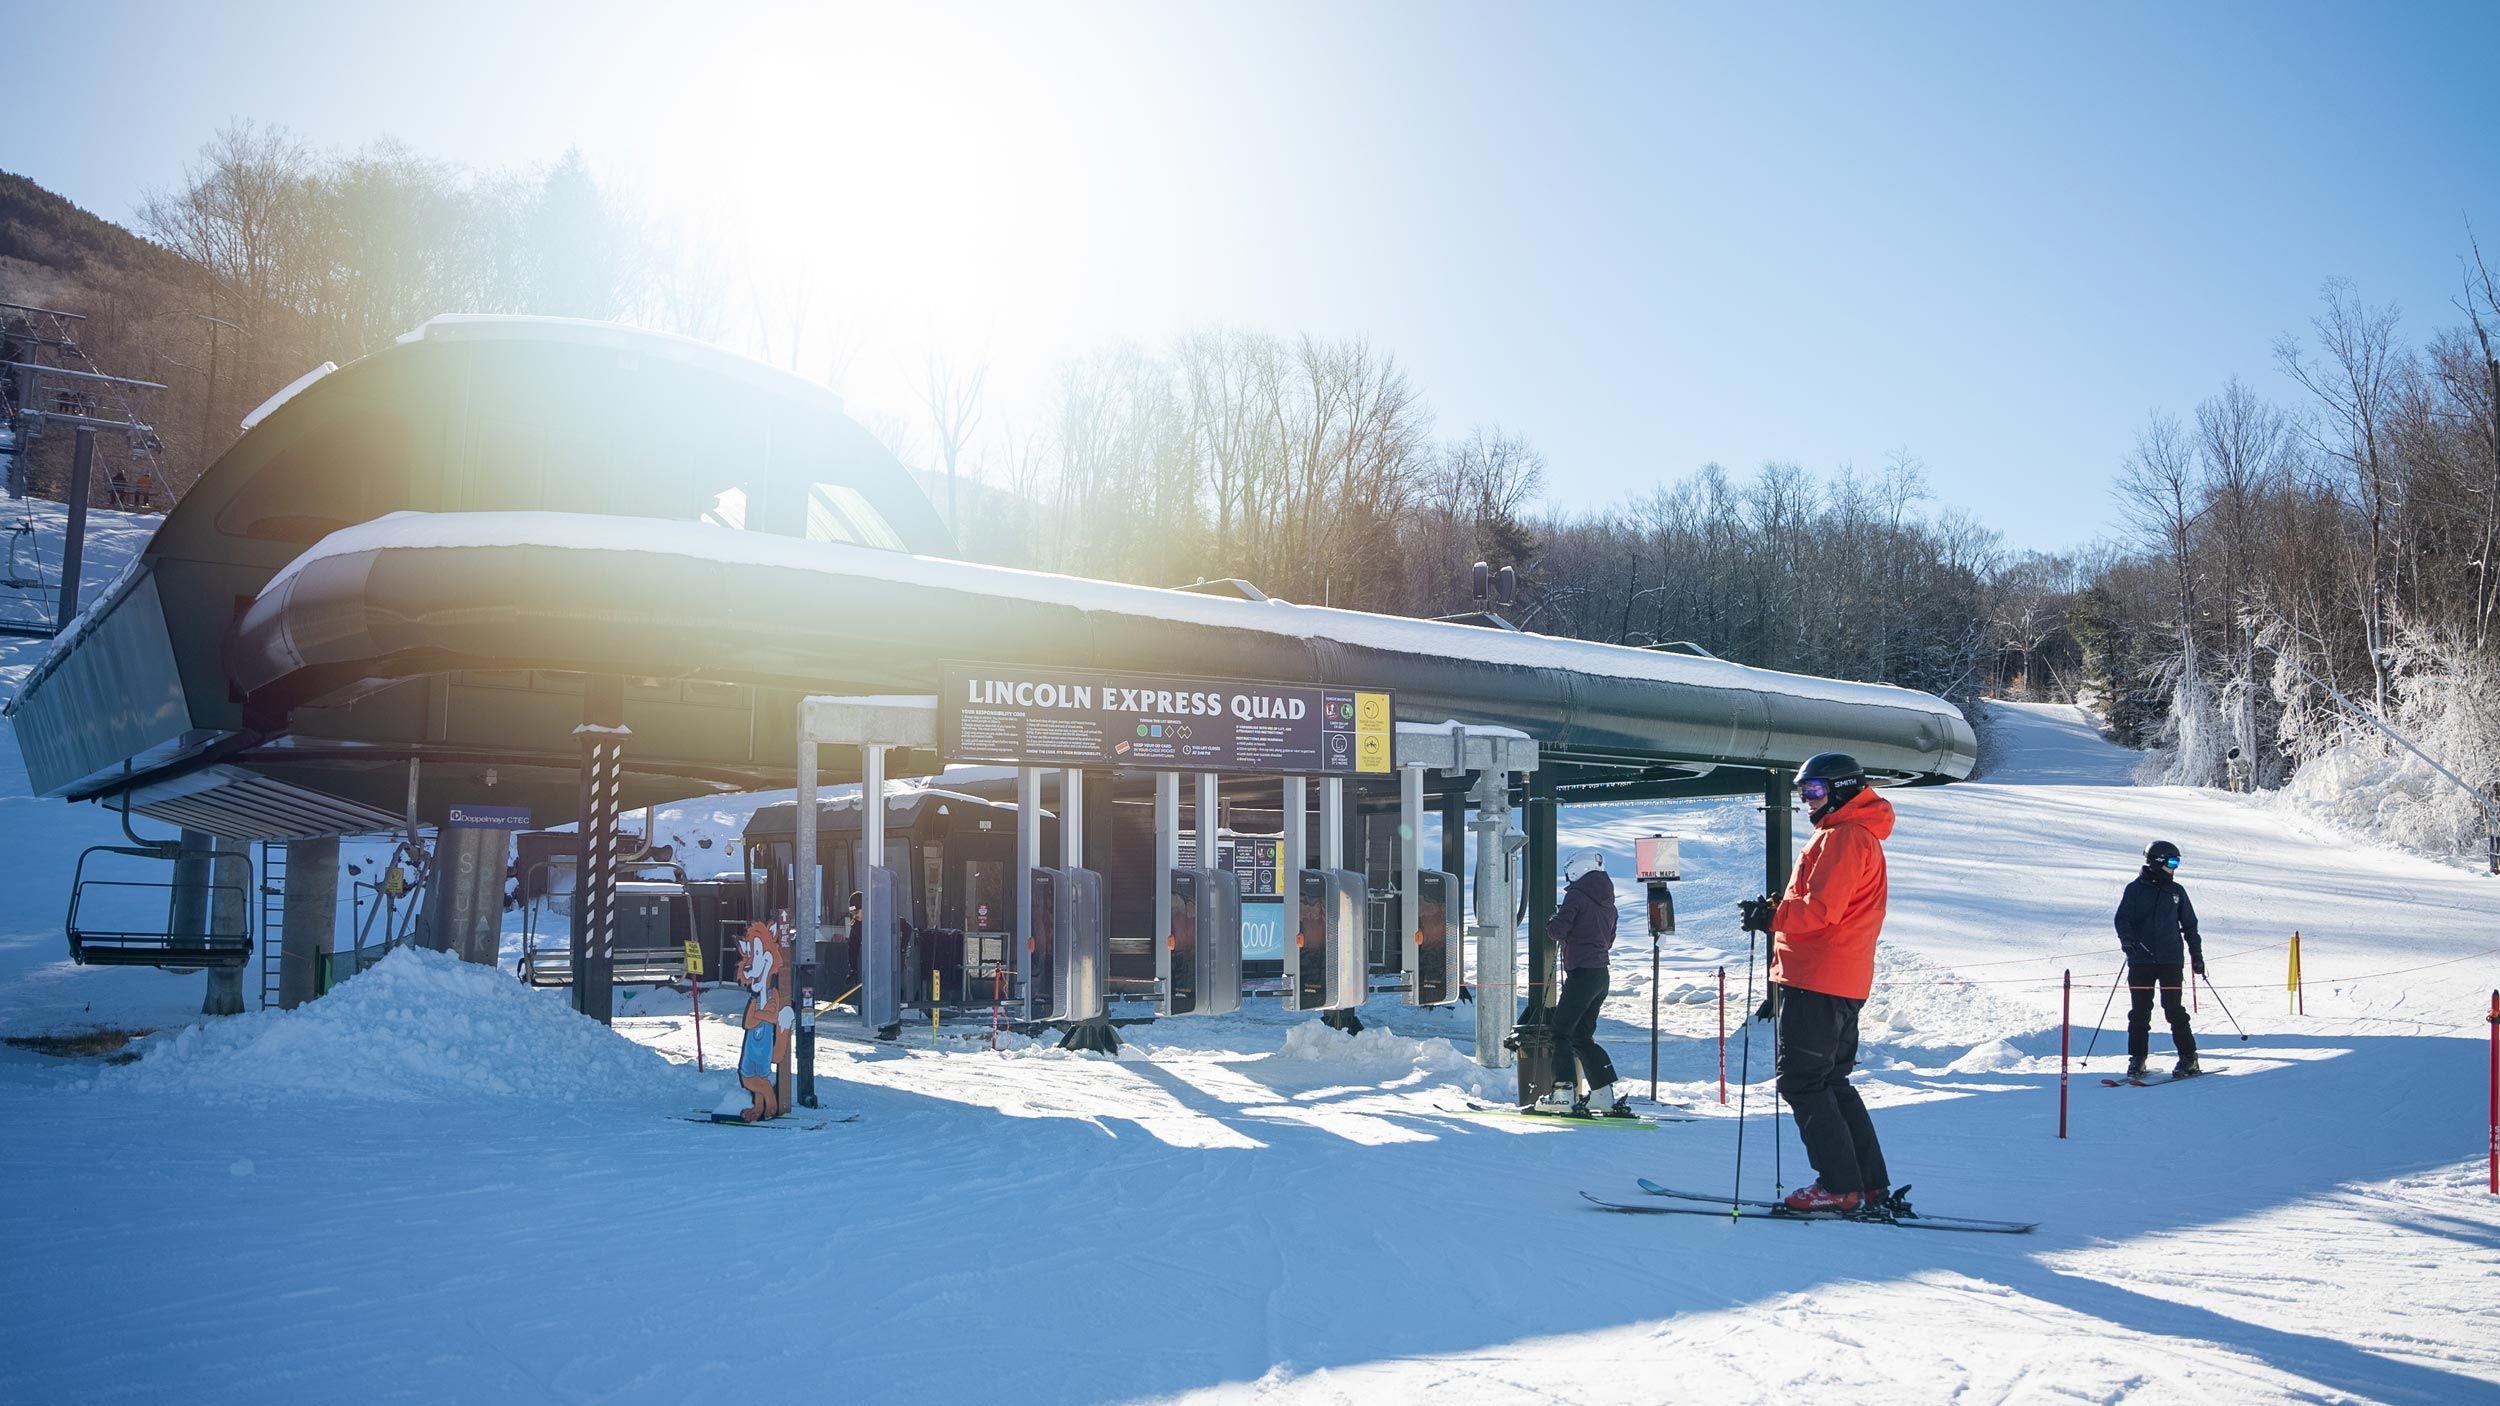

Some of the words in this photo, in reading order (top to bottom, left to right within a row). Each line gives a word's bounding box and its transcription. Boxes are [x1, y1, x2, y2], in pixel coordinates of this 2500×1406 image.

[969, 680, 1091, 708] LINCOLN
[1102, 687, 1222, 716] EXPRESS
[1230, 694, 1306, 721] QUAD
[1834, 779, 1857, 788] SMITH
[461, 815, 505, 825] Doppelmayr
[506, 816, 530, 824] CTEC
